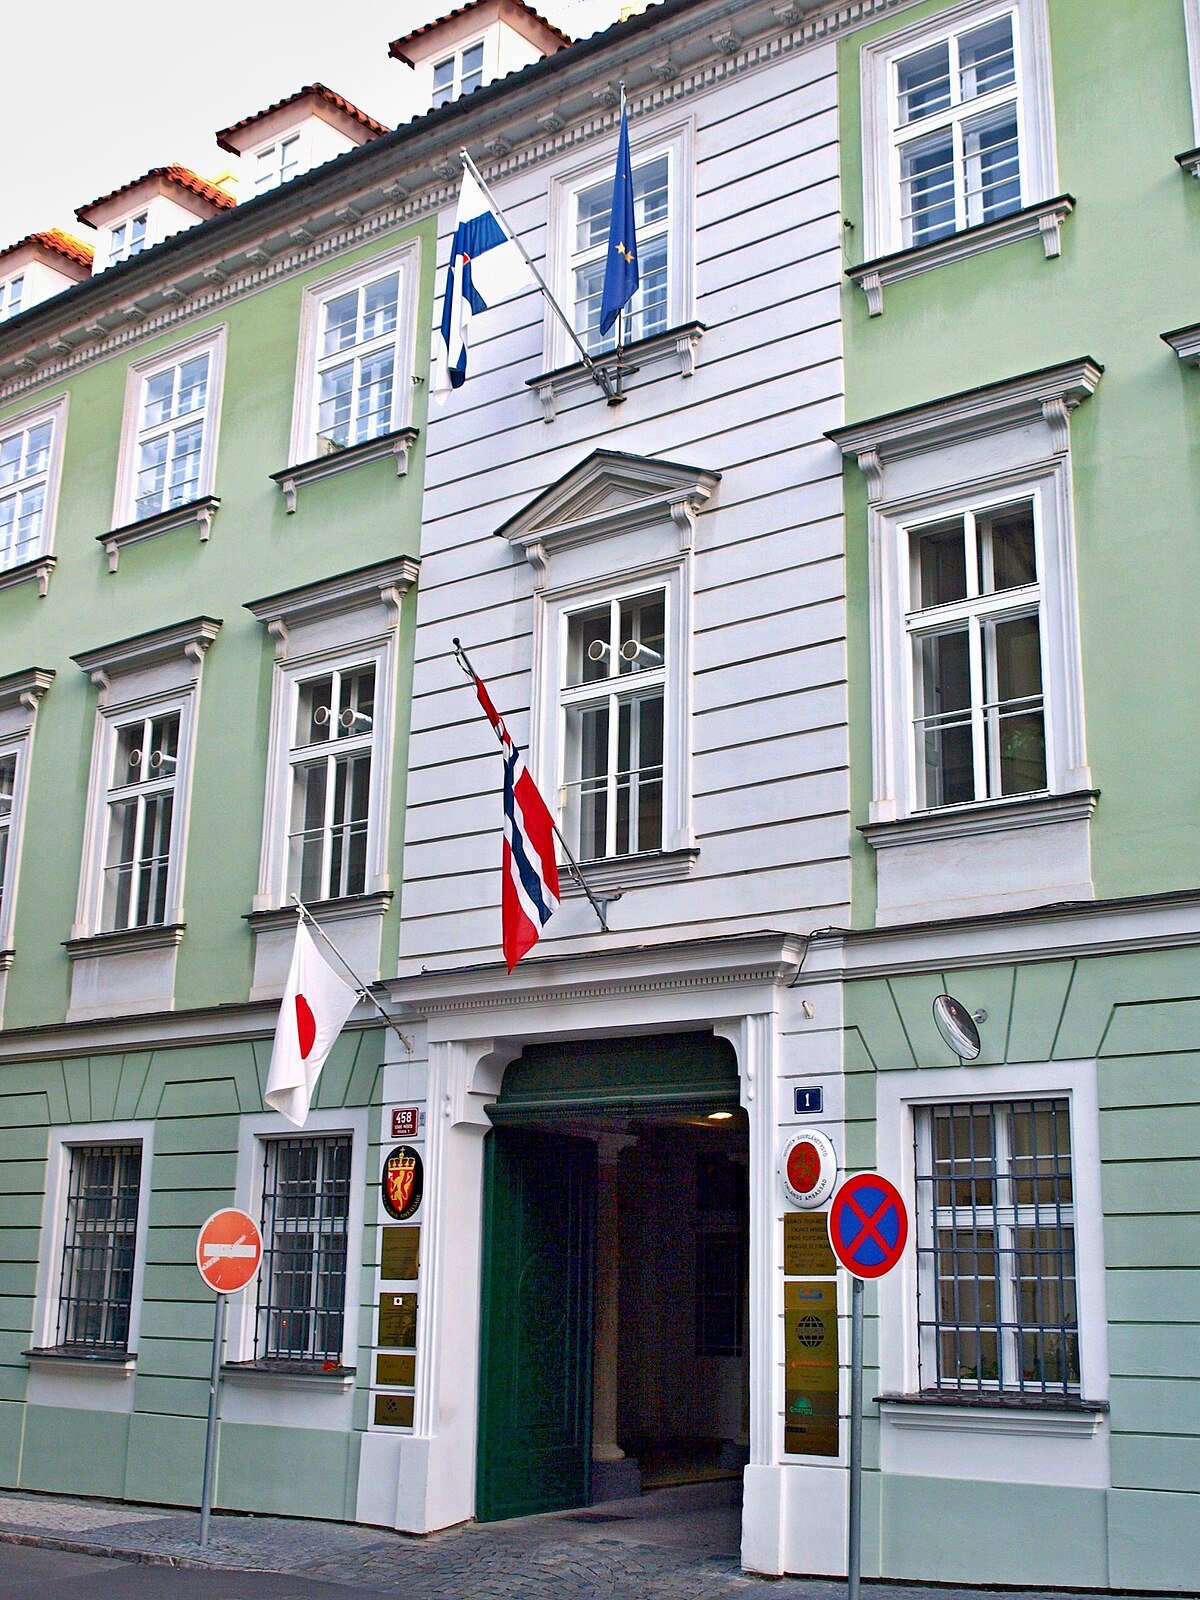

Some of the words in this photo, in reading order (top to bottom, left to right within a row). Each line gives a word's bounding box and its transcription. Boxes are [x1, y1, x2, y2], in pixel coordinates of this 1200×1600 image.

[805, 1093, 810, 1107] 1
[395, 1111, 412, 1124] 458
[805, 1178, 827, 1201] AMBASSAD
